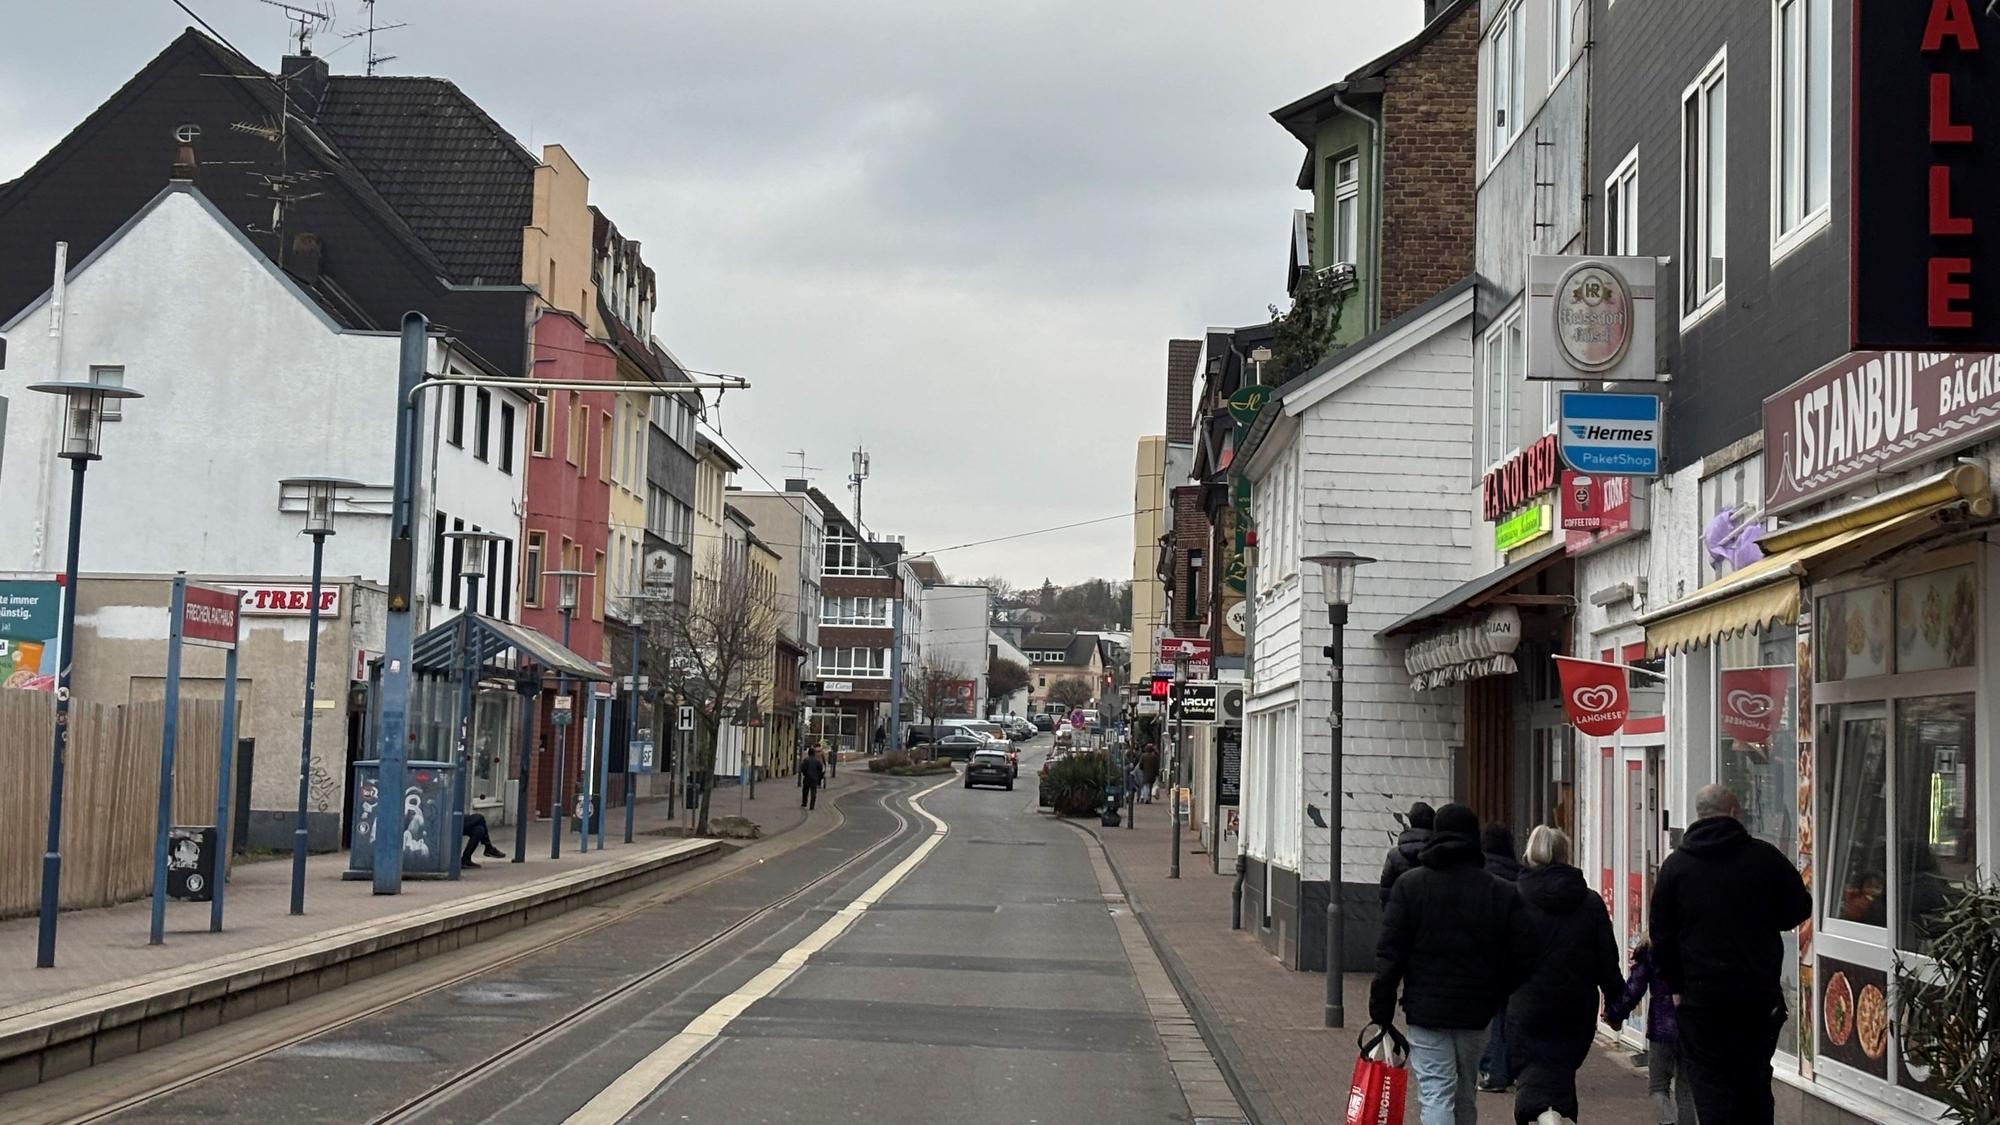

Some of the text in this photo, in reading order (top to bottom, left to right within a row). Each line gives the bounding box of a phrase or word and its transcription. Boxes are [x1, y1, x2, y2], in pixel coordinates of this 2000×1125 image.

[1794, 353, 1918, 480] ISTANBUL
[1587, 425, 1653, 442] Hermes
[1583, 452, 1652, 467] PaketShop
[1603, 477, 1623, 512] KIOSK
[1564, 518, 1585, 528] COFFEE
[10, 594, 39, 605] immer
[1184, 688, 1198, 696] MY
[681, 708, 692, 728] H
[1576, 711, 1623, 724] LANGNESE
